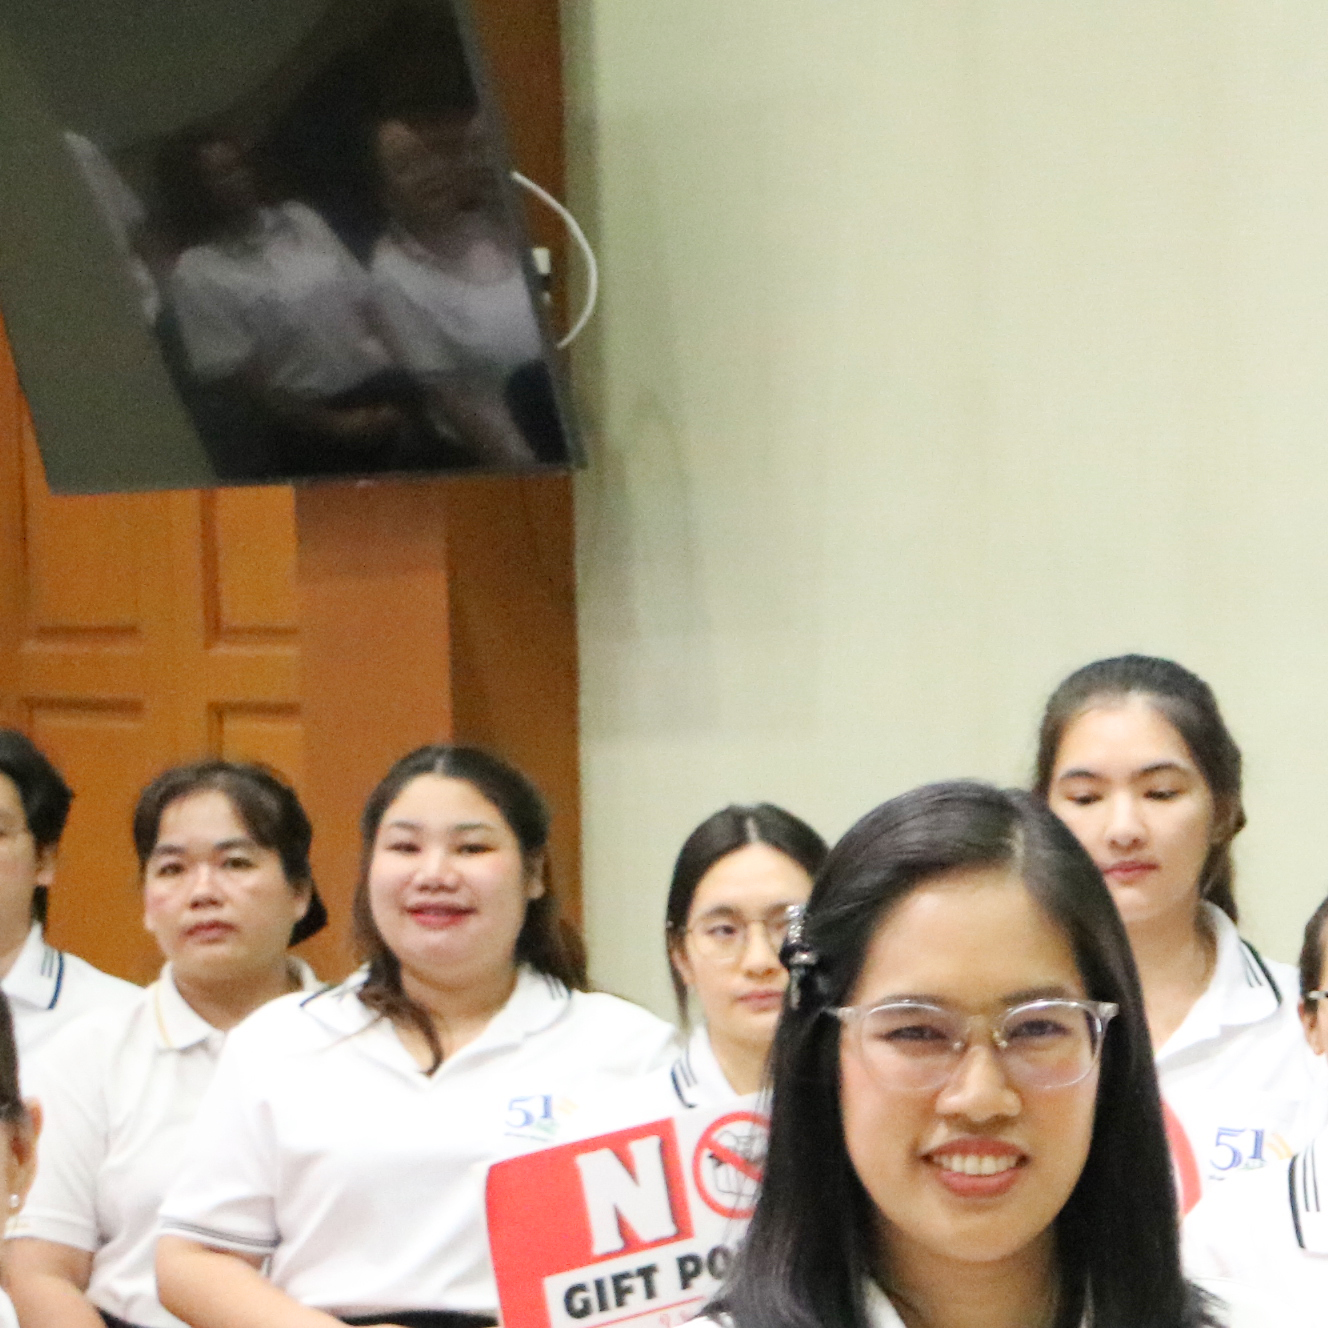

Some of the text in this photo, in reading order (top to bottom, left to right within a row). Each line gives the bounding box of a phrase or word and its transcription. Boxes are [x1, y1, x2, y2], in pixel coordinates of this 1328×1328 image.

[505, 1094, 553, 1128] 51
[1209, 1127, 1265, 1171] 51
[563, 1262, 659, 1320] GIFT
